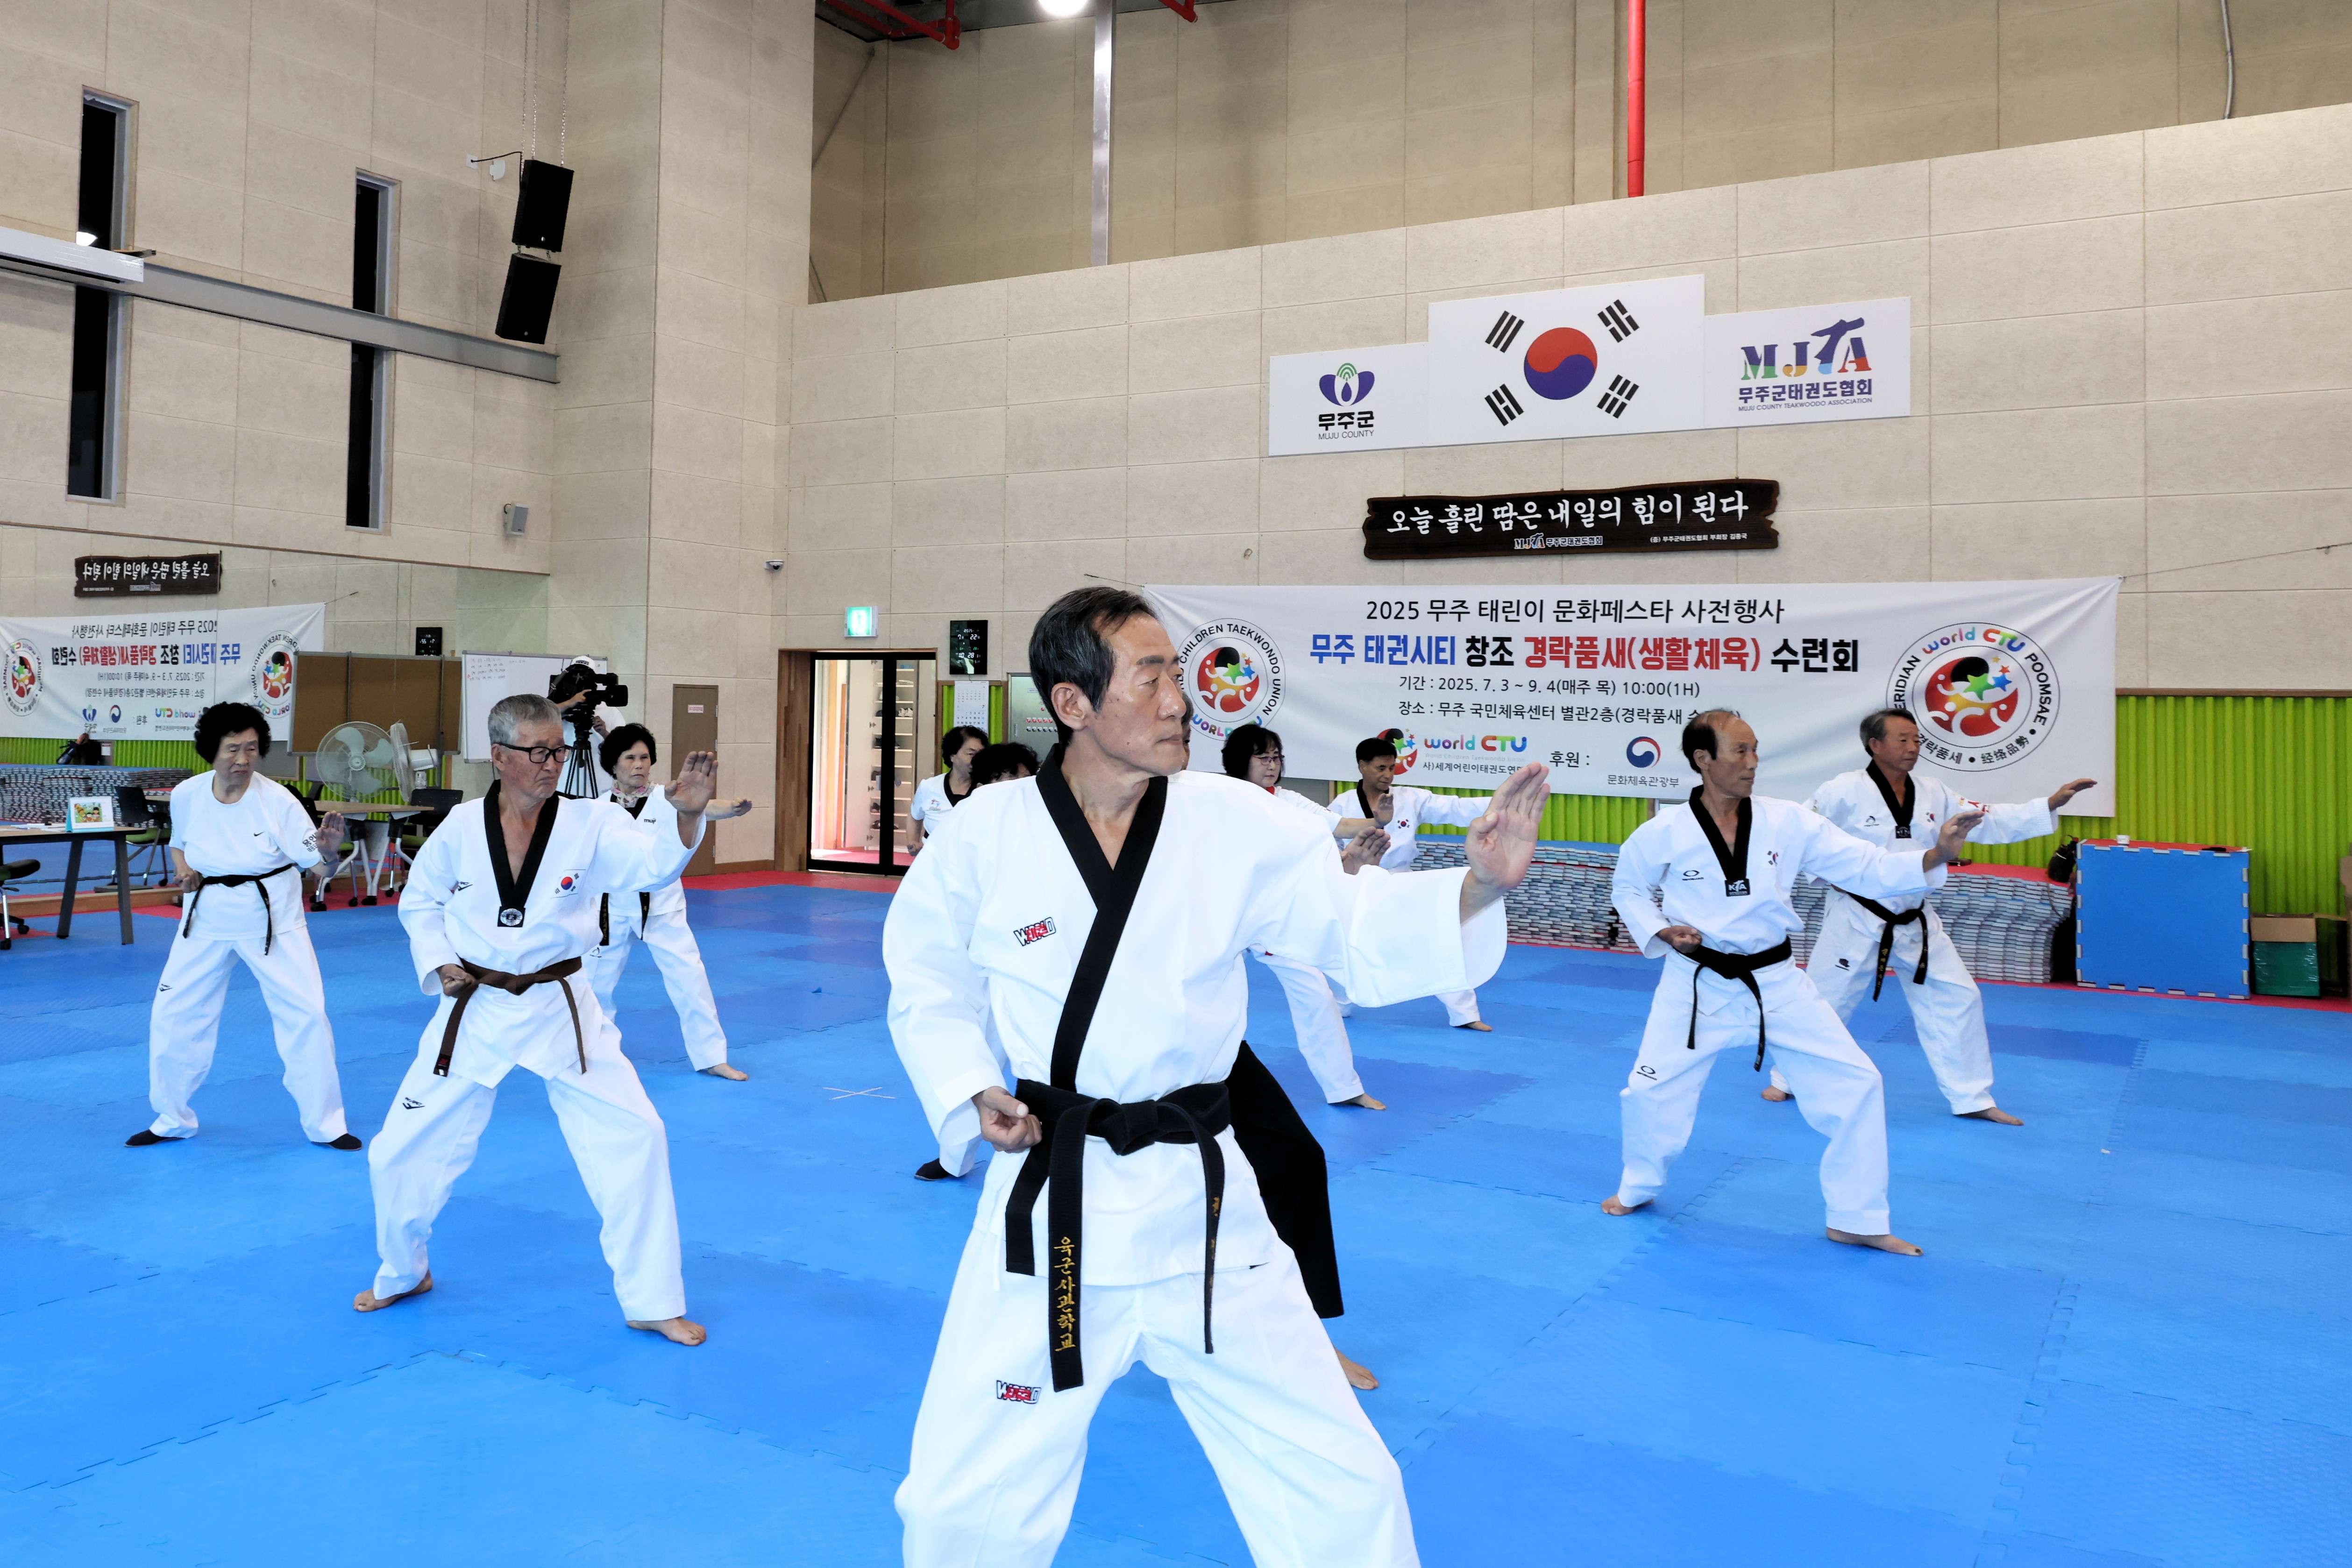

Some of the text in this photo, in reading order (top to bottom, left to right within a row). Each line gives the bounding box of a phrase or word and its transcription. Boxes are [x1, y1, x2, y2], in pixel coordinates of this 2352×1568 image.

[1741, 317, 1872, 380] MJTA
[1739, 379, 1872, 404] 무주군태권도협회
[1827, 397, 1873, 406] ASSOCIATION
[1319, 411, 1374, 431] 무주군
[1342, 429, 1374, 438] COUNTY
[1386, 490, 1749, 534] 오늘 흘린 땀은 내일의 힘이 된다
[1546, 536, 1603, 547] 무주군태권도협회
[1662, 534, 1708, 542] 무주군태권도협회
[1367, 599, 1784, 624] 2025 무주 태린이 문화페스타 사전행사
[1310, 634, 1858, 673] 무주 태권시티 창조 경락품새(생활체육) 수련회
[1180, 624, 1281, 715] CHILDREN TAEKWONDO UNION
[1922, 627, 2052, 726] world CTU POOMSAE
[1400, 676, 1426, 690] 기간
[1439, 678, 1477, 691] 2025.
[1484, 679, 1495, 692] 7.
[1501, 680, 1508, 691] 3
[1529, 680, 1541, 693] 9.
[1547, 680, 1591, 695] 4(매주
[1596, 681, 1615, 695] 목)
[1623, 682, 1699, 698] 10:00(1H)
[1895, 655, 1921, 710] ERIDIAN
[1399, 702, 1425, 715] 장소
[1438, 702, 1465, 717] 무주
[1470, 703, 1554, 720] 국민체육센터
[1562, 706, 1682, 724] 별관2층(경락품새
[1424, 734, 1527, 752] world CTU
[1549, 752, 1579, 767] 후원
[1607, 775, 1679, 788] 문화체육관광부
[1053, 1236, 1076, 1352] 육군사관학교
